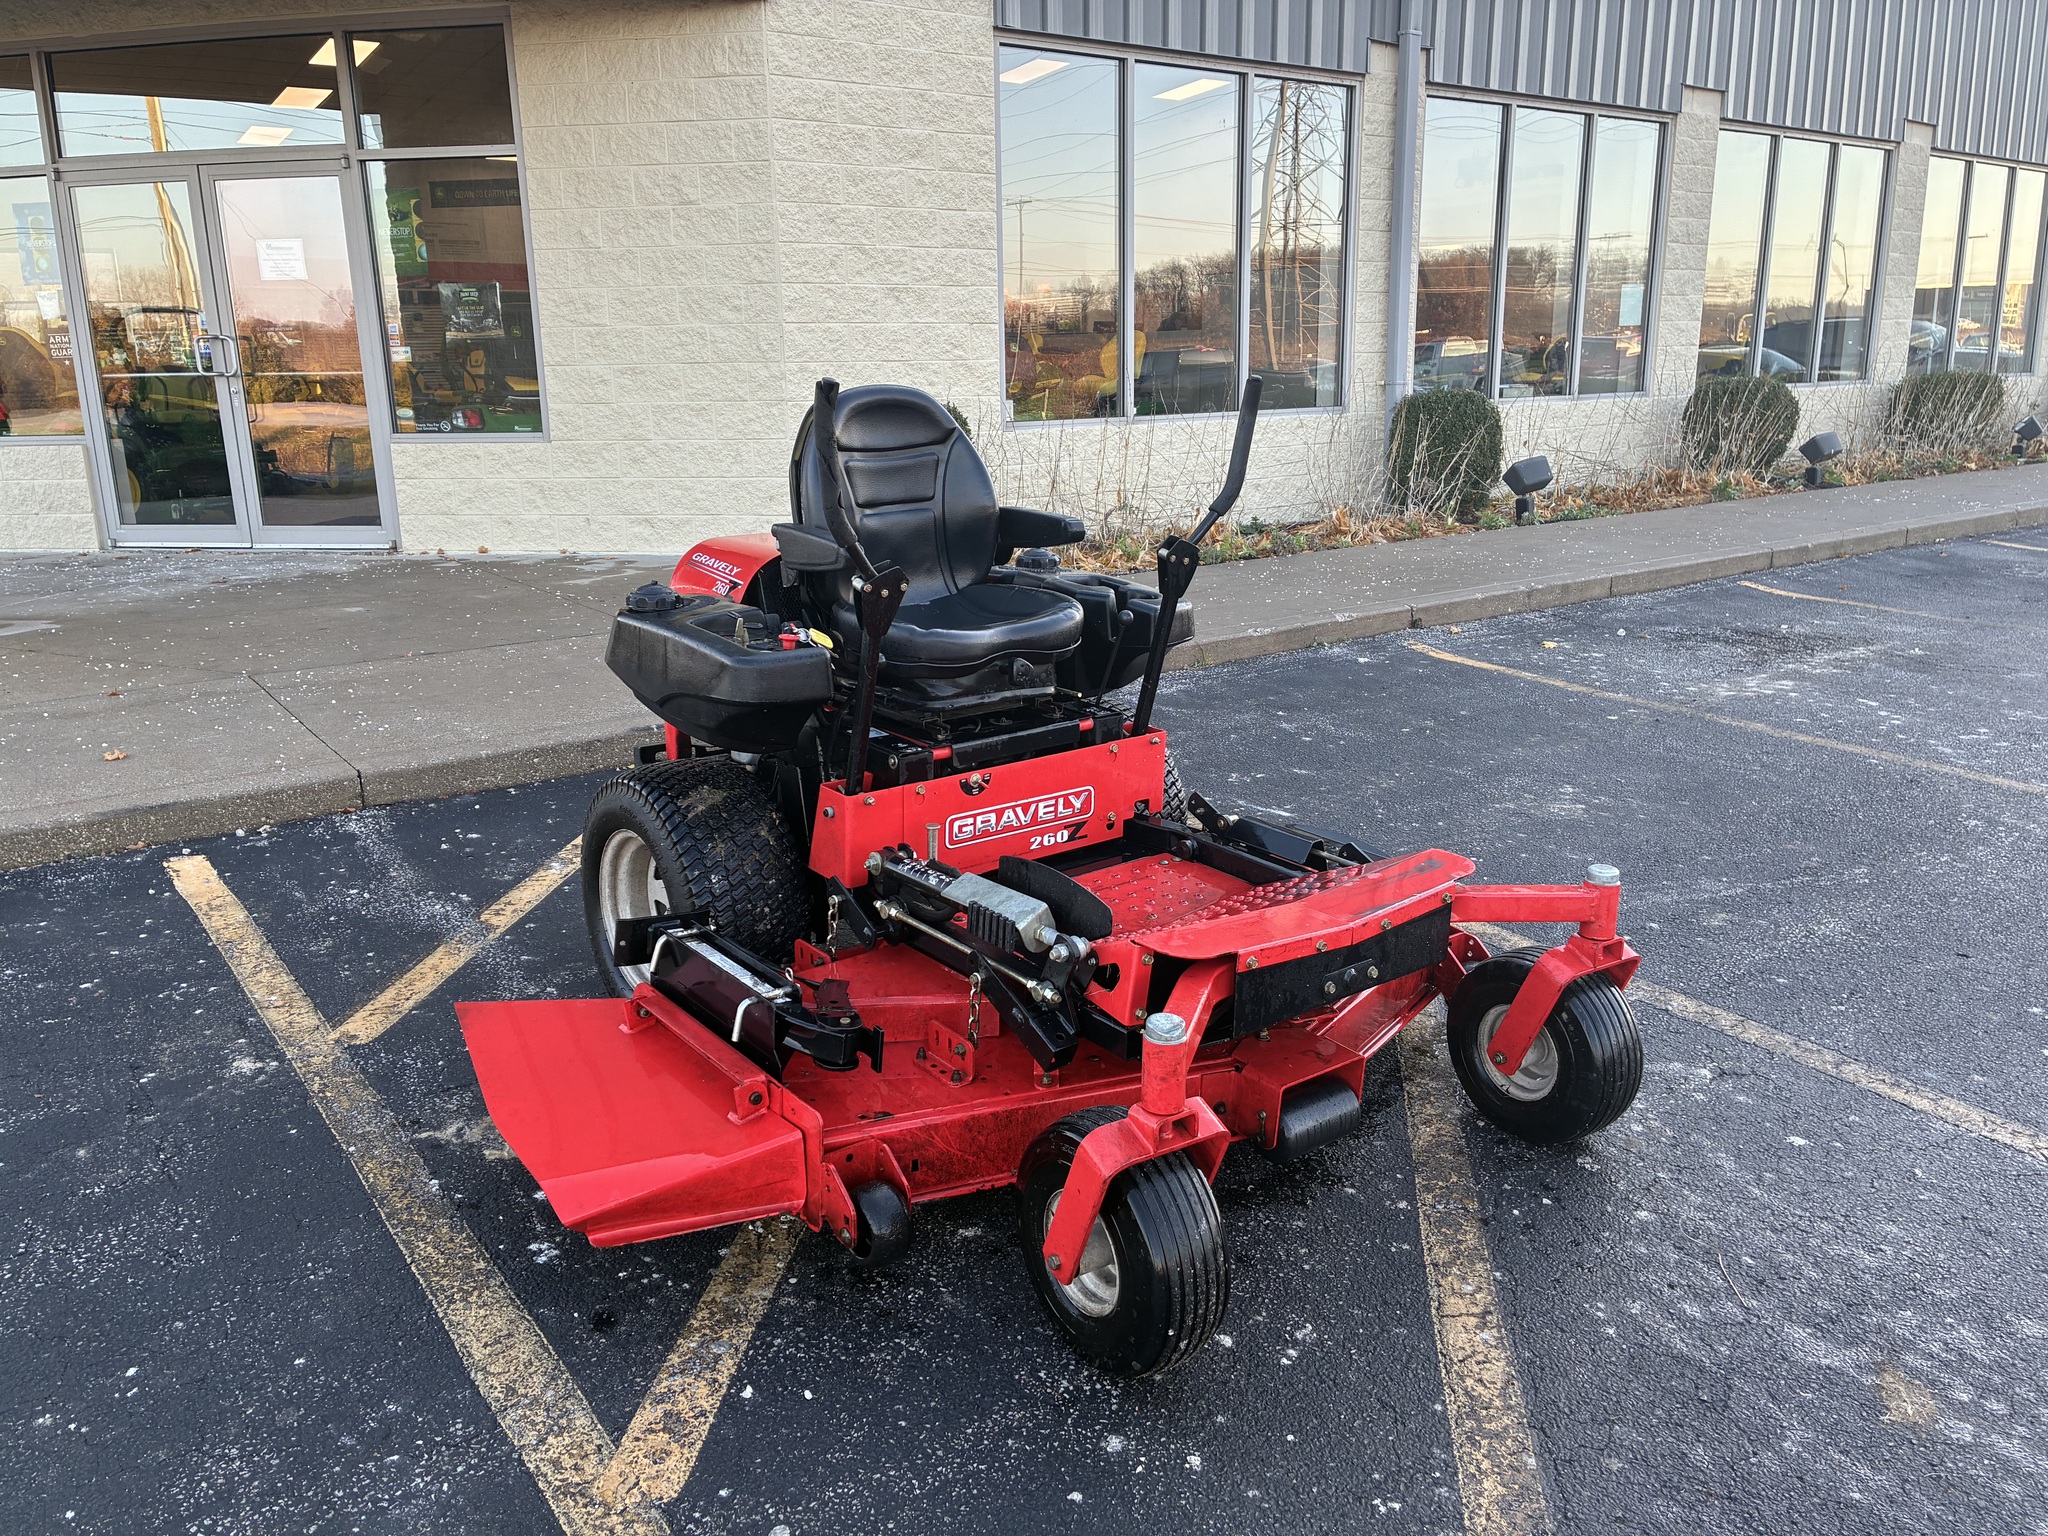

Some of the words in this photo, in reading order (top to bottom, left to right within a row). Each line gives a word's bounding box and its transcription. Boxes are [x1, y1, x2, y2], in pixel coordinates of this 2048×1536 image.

[49, 335, 71, 344] ARM
[51, 348, 73, 356] GUAR
[692, 552, 743, 576] GRAVELY
[952, 791, 1089, 841] GRAVELY
